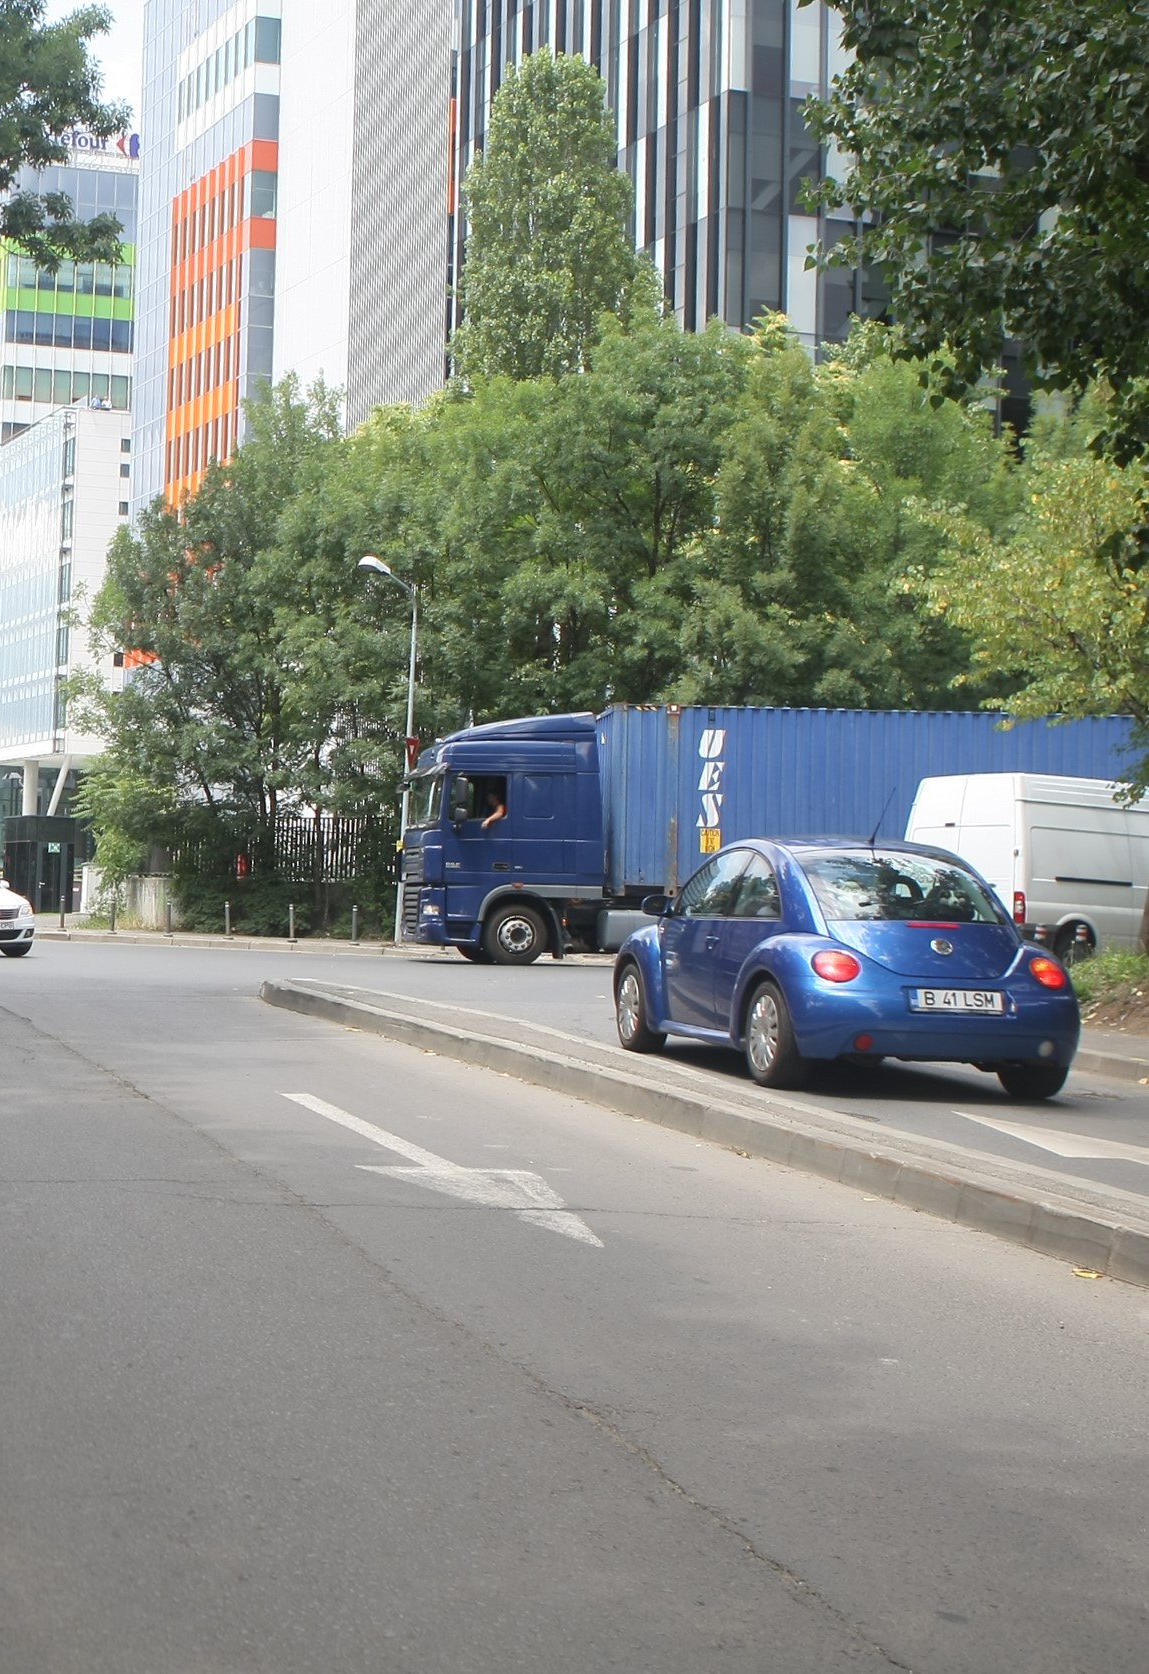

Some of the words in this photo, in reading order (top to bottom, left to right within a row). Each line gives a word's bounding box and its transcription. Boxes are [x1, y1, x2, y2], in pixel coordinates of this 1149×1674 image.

[695, 729, 727, 828] UES
[923, 991, 936, 1006] B
[943, 991, 957, 1007] 41
[963, 992, 995, 1009] LSM
